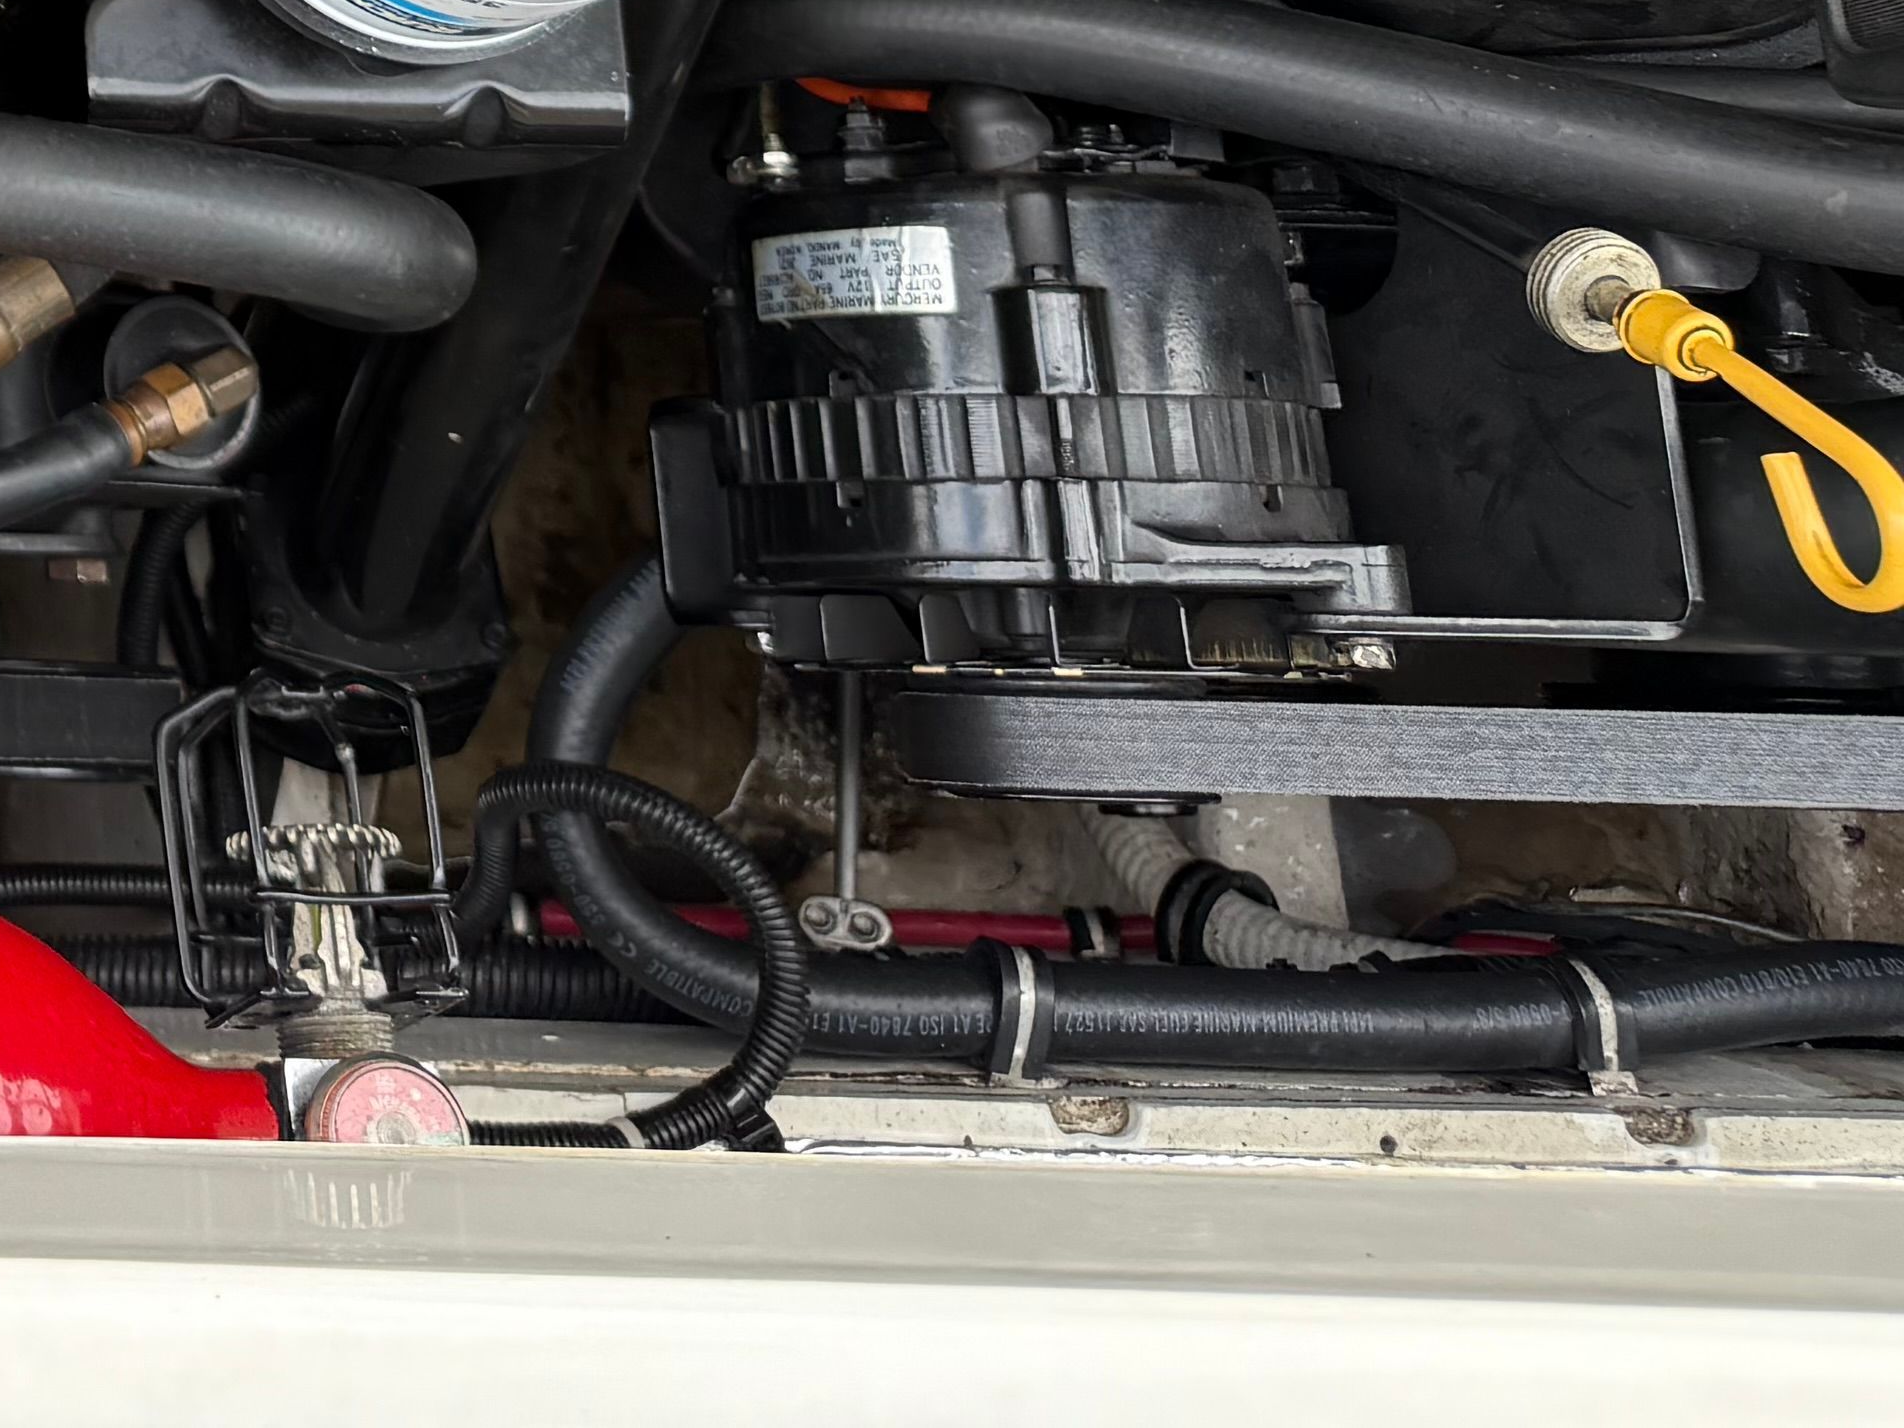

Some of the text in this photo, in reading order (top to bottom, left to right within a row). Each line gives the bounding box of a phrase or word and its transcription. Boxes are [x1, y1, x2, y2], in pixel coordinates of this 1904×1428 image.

[809, 252, 856, 266] MARINE
[838, 265, 869, 279] PART
[884, 263, 940, 277] VENDOR
[887, 277, 942, 291] OUTPUT
[829, 294, 874, 310] MARINE
[880, 292, 943, 307] MERCURY
